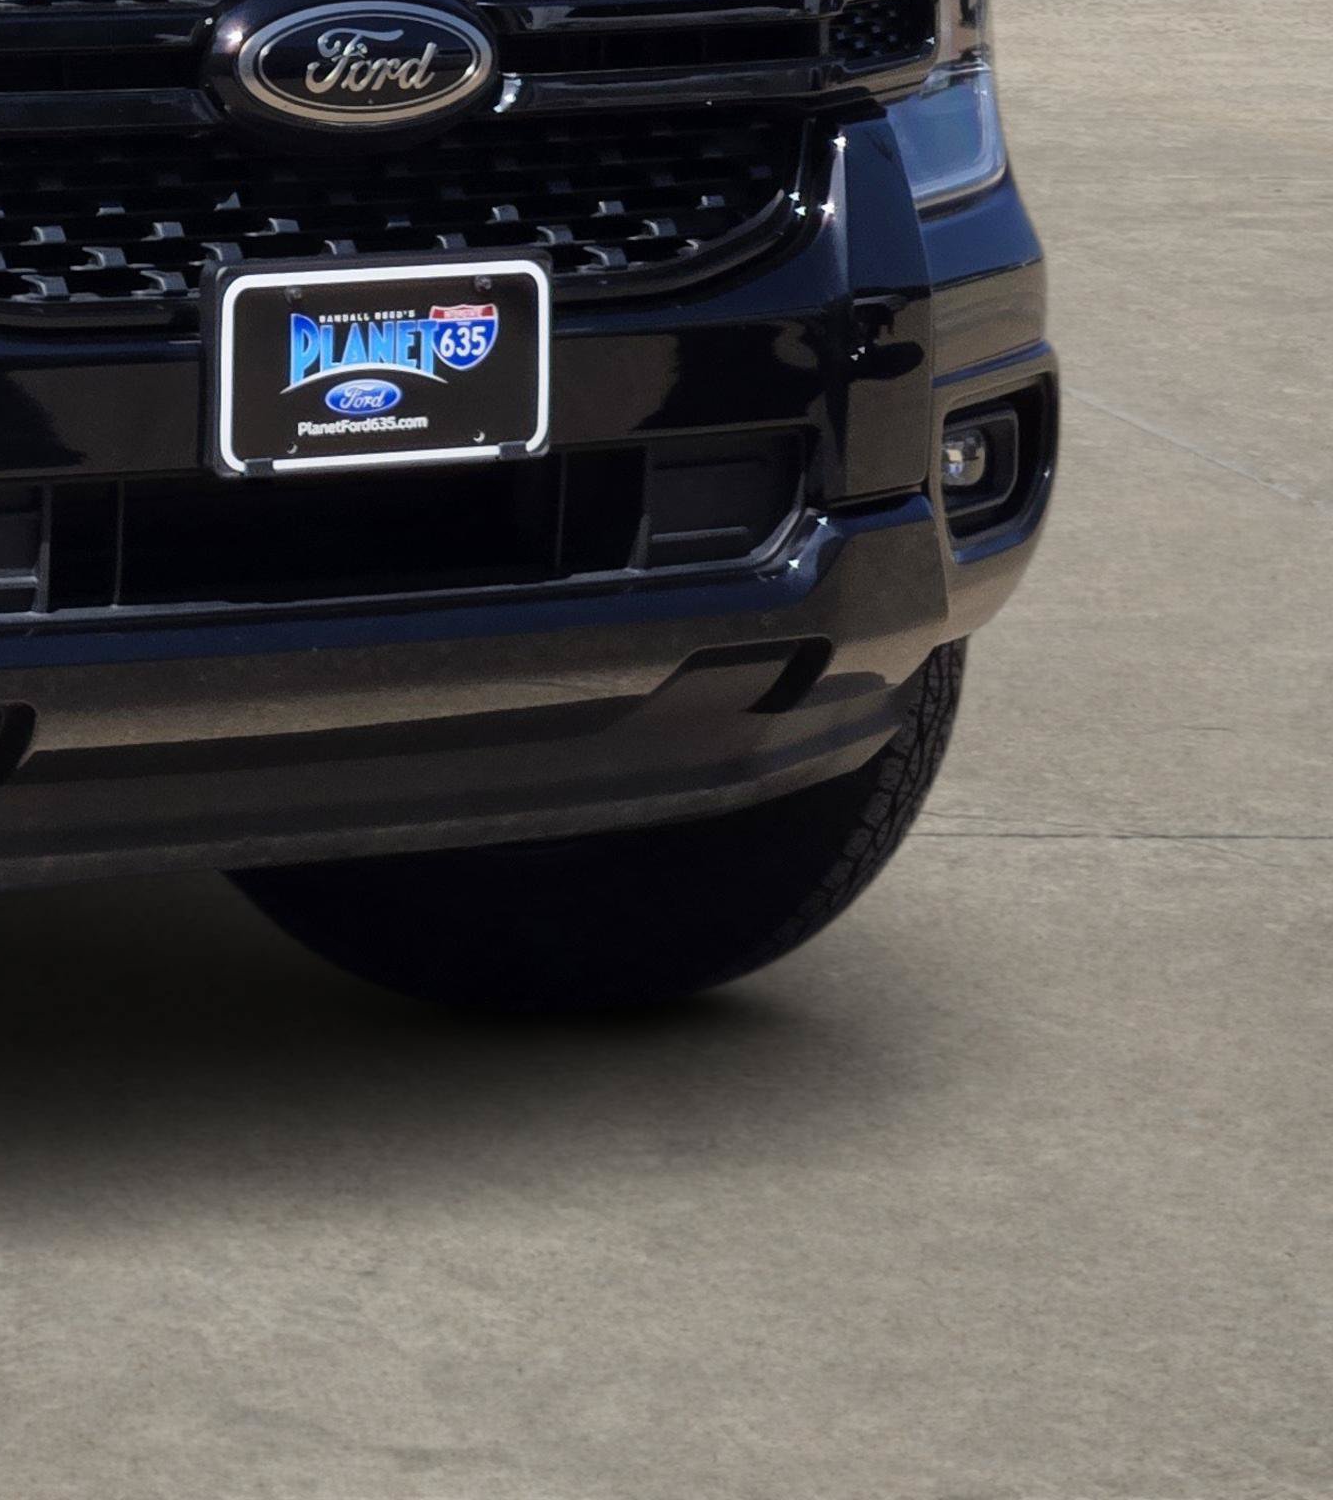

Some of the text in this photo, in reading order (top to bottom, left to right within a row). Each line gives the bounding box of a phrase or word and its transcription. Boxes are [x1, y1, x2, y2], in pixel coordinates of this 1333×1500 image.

[306, 28, 437, 93] Ford
[290, 314, 439, 387] PLANET
[439, 326, 488, 358] 635
[339, 385, 388, 409] Ford
[298, 416, 428, 437] PlanetFord635.com
